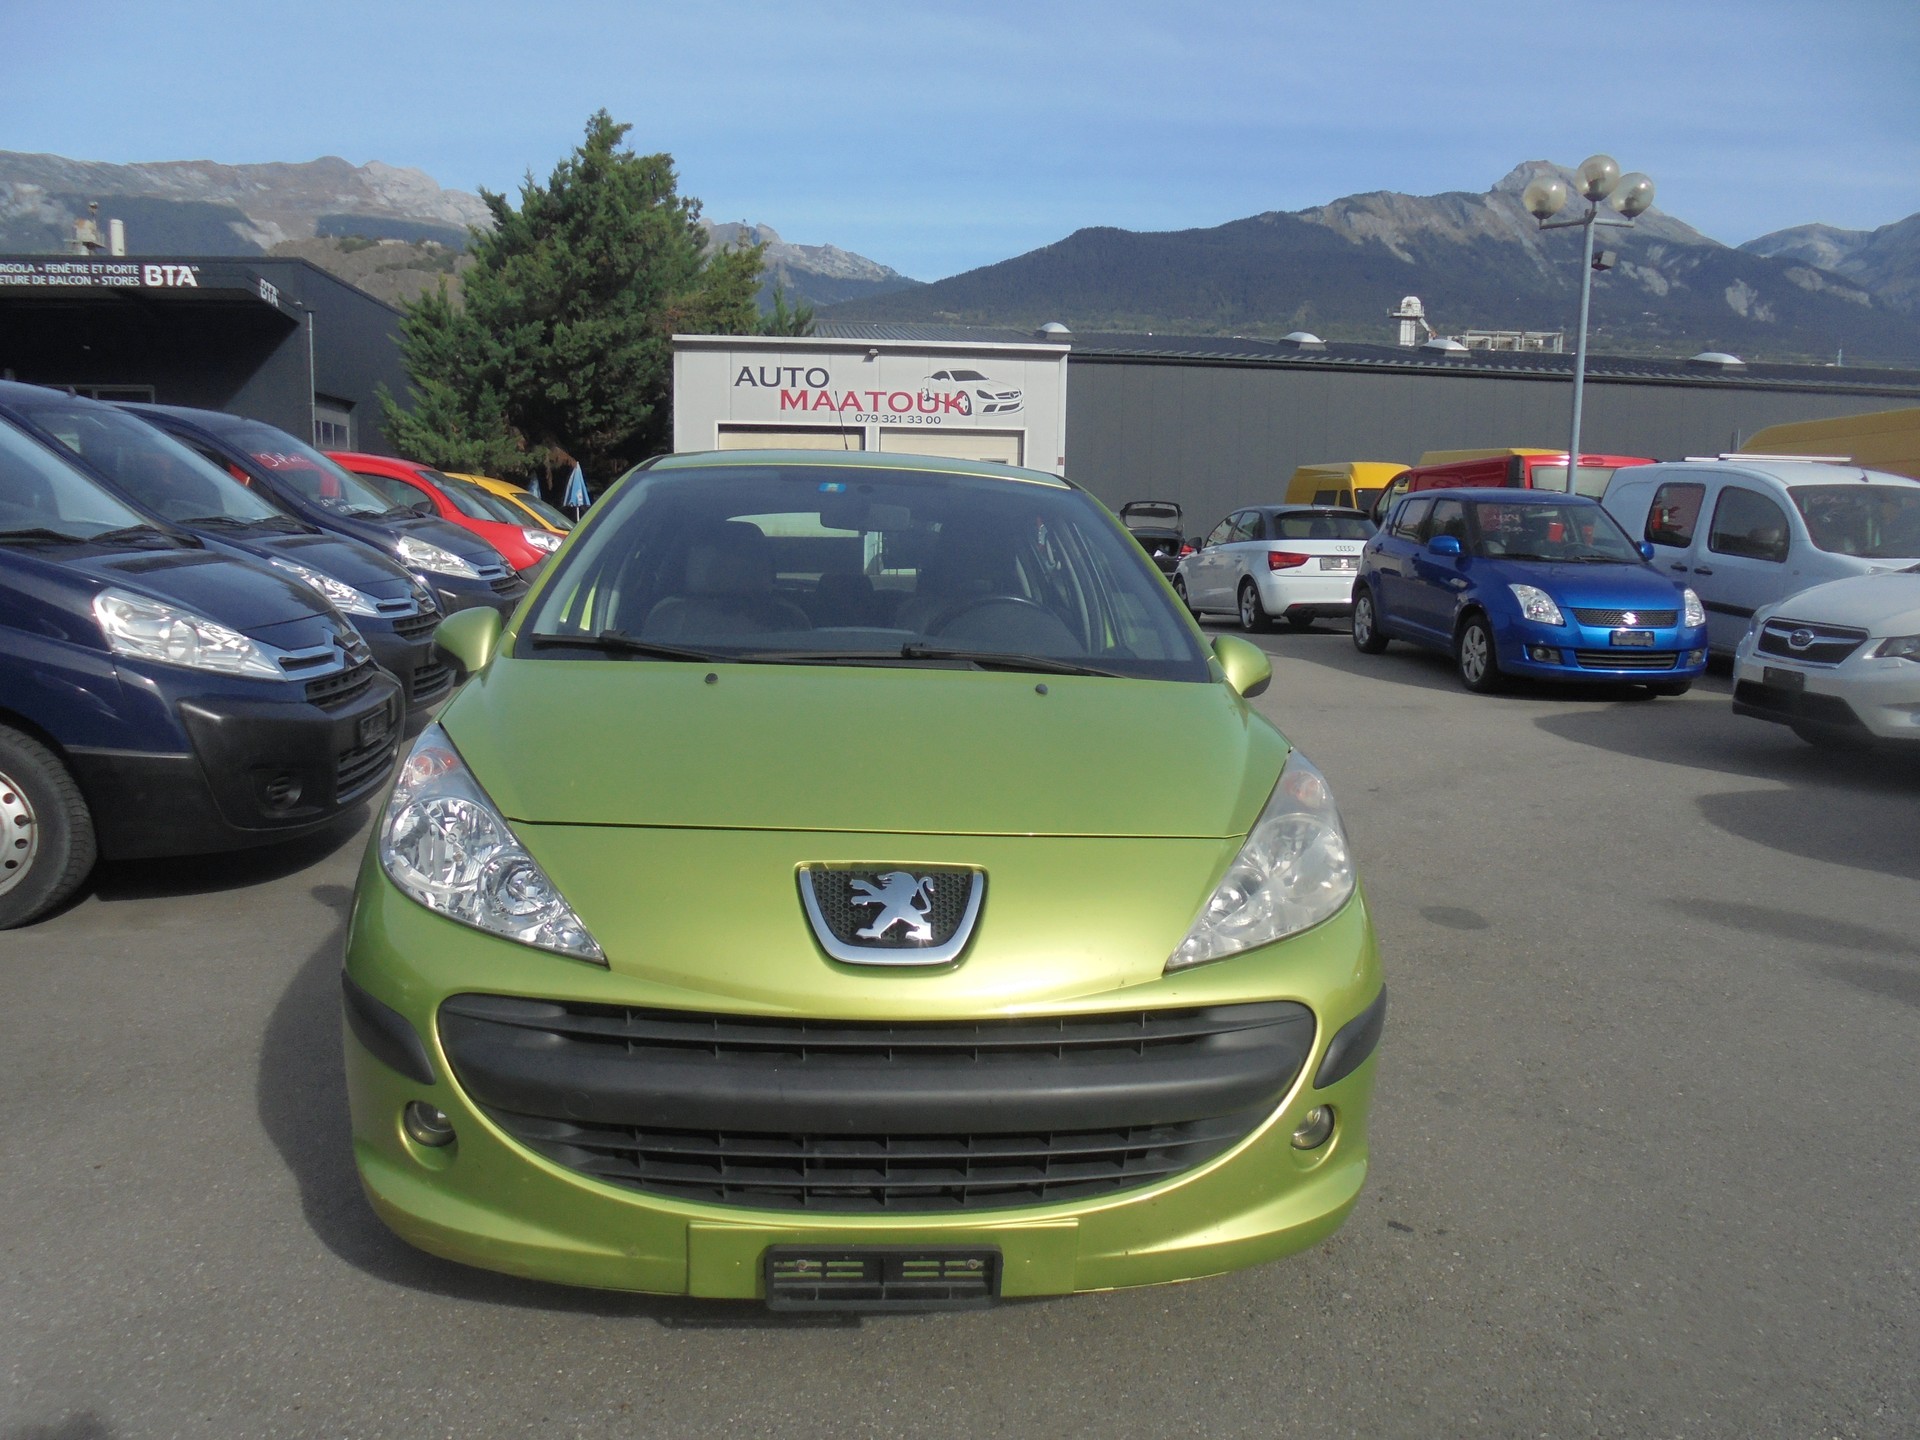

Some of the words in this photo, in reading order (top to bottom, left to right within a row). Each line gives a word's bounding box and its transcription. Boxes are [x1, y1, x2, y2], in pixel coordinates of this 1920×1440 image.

[45, 262, 90, 274] FENÊTRE
[91, 264, 104, 274] ET
[106, 264, 140, 274] PORTE
[144, 264, 198, 287] BTA
[32, 275, 47, 285] DE
[48, 275, 92, 286] BALCON
[101, 275, 140, 286] STORES
[734, 366, 830, 389] AUTO
[780, 389, 966, 414] MAATOUK
[855, 413, 879, 423] 079
[881, 414, 902, 424] 321
[907, 415, 923, 425] 33
[925, 415, 942, 425] 00
